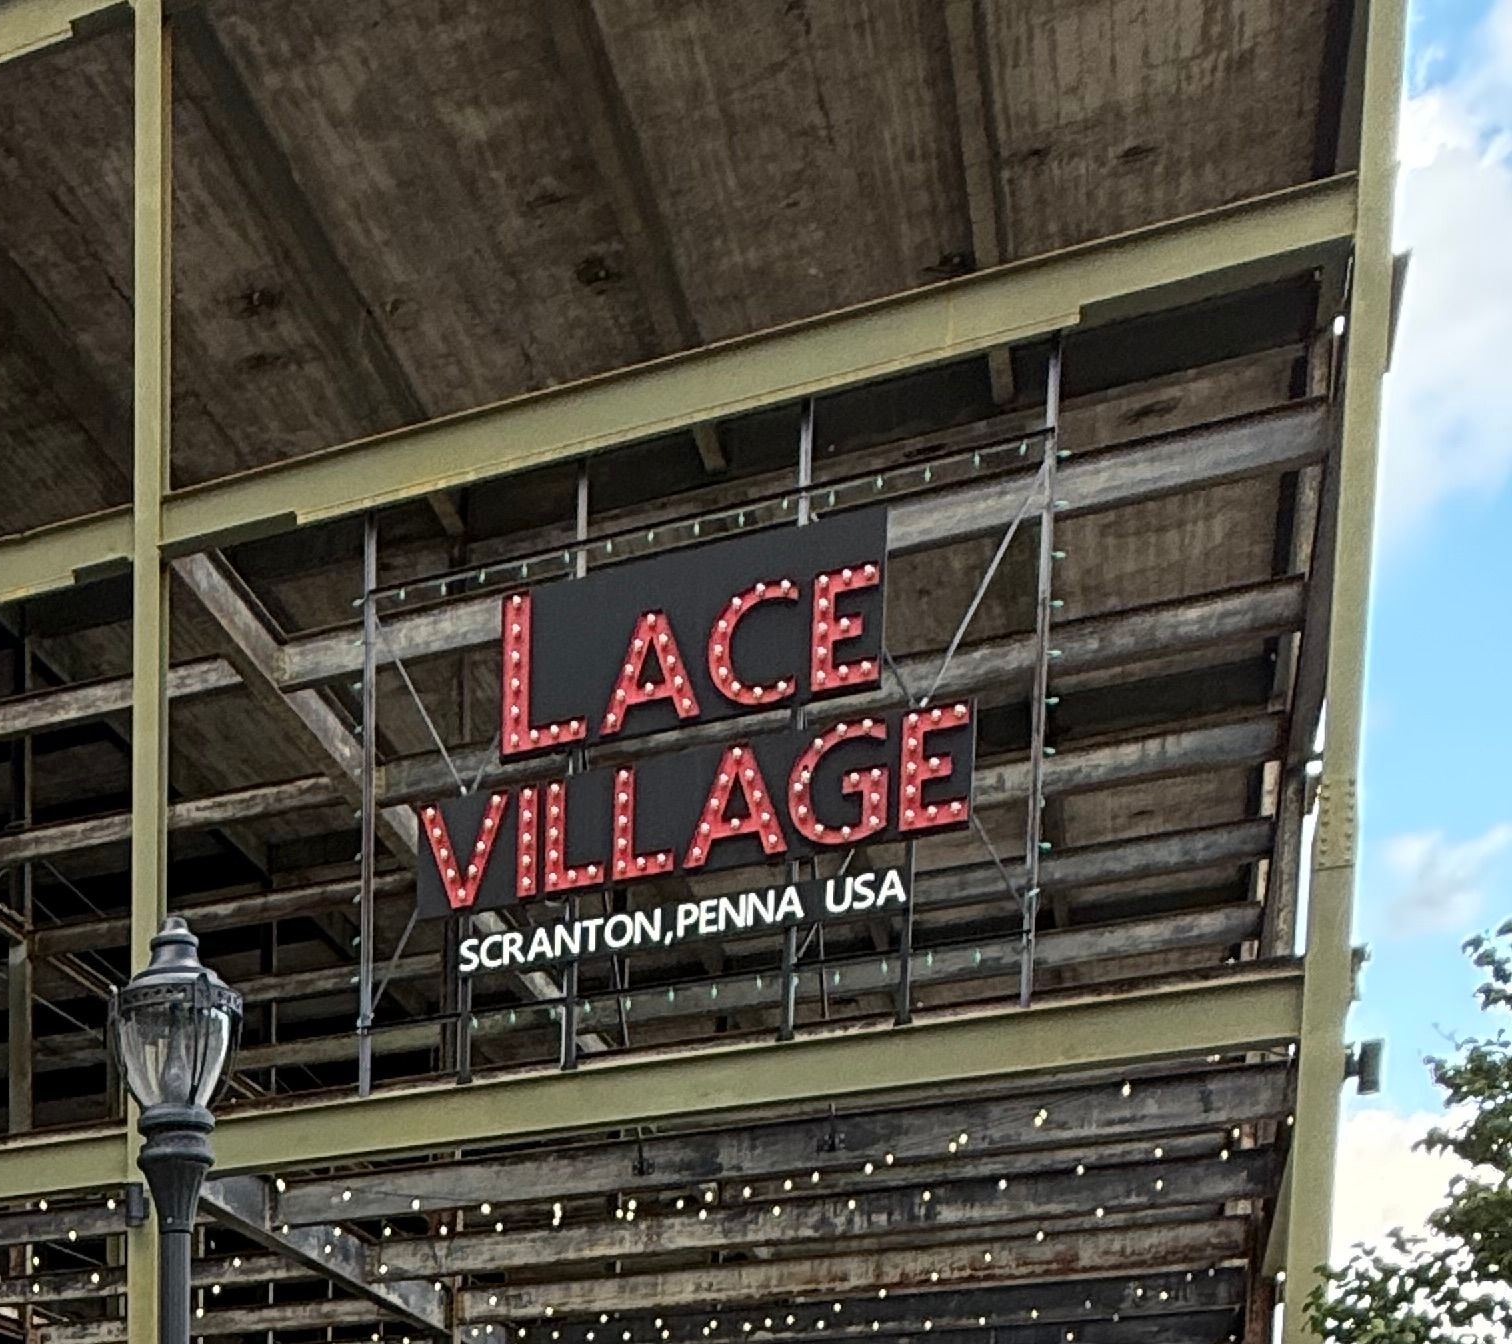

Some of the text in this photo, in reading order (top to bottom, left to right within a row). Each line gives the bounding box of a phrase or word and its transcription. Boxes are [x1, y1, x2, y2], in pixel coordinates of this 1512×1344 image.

[501, 561, 881, 760] LACE
[420, 702, 971, 909] VILLAGE
[825, 868, 907, 914] USA
